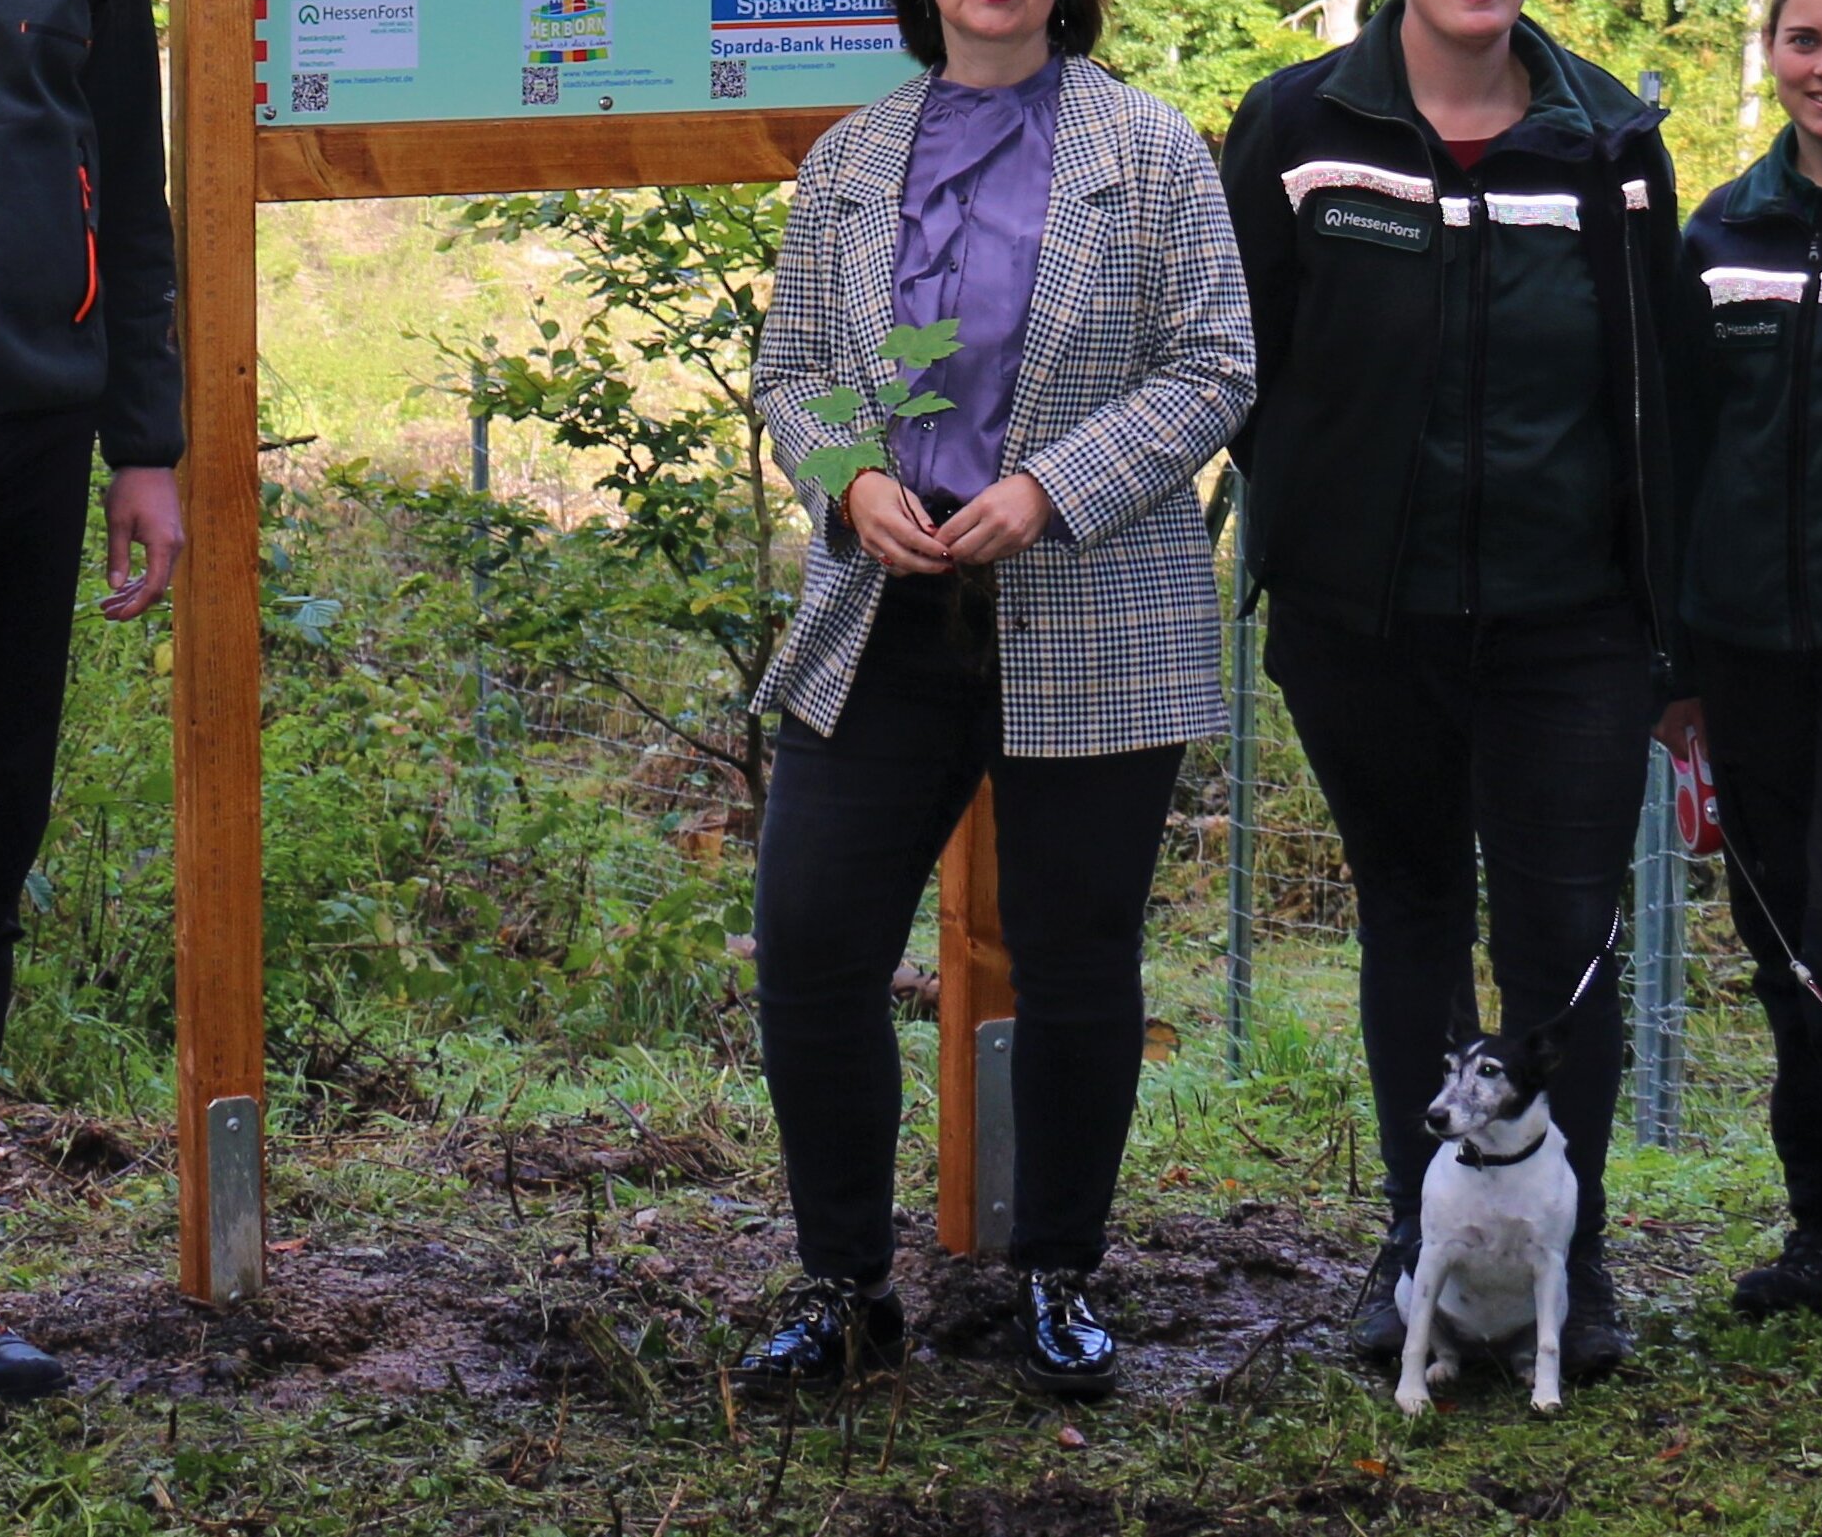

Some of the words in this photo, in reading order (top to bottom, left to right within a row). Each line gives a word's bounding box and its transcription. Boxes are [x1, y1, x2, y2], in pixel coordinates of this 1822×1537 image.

[323, 5, 414, 20] HessenForst
[531, 17, 606, 37] HERBORN
[711, 37, 824, 57] Sparda-Bank
[831, 36, 893, 51] Hessen
[1342, 212, 1422, 240] HessenForst
